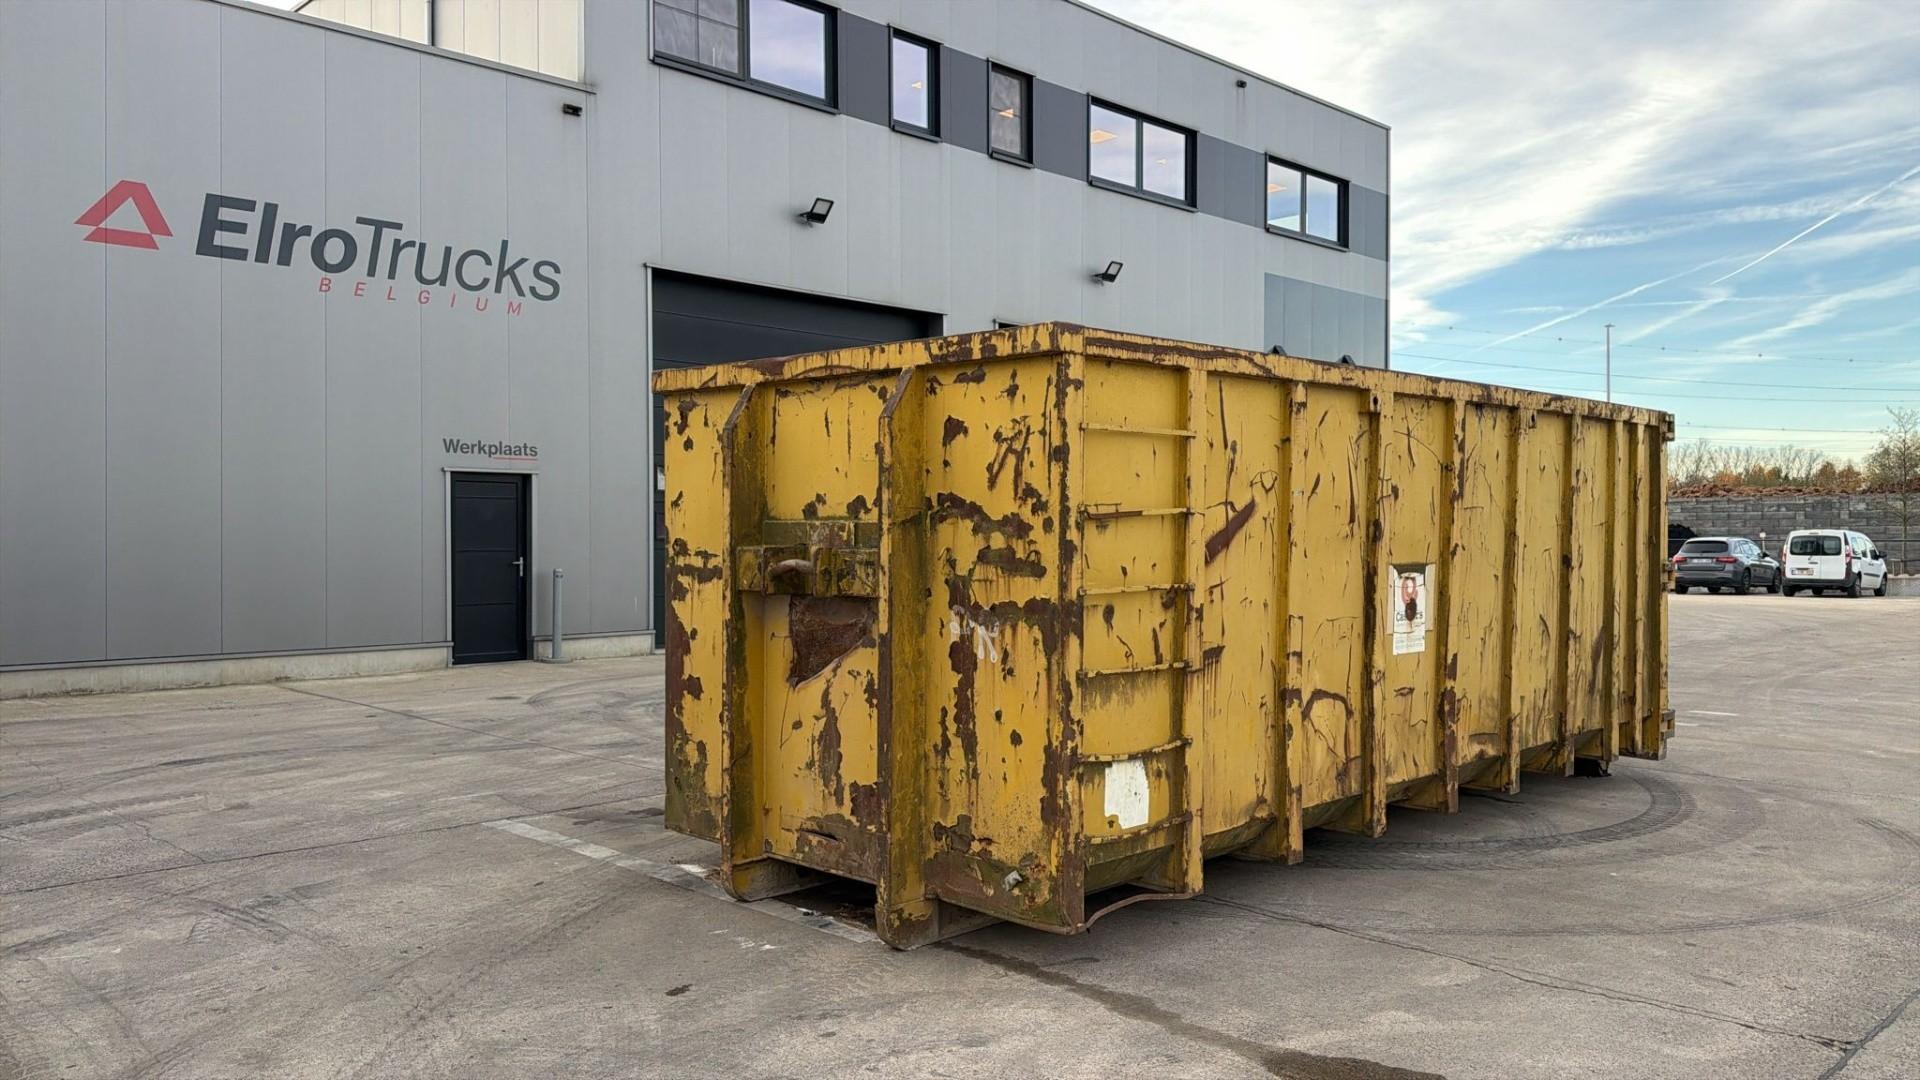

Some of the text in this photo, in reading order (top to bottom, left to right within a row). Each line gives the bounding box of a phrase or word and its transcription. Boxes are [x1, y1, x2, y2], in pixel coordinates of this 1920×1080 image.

[195, 193, 562, 301] ElroTrucks
[318, 277, 523, 316] BELGIUM
[442, 438, 538, 458] Werkplaats
